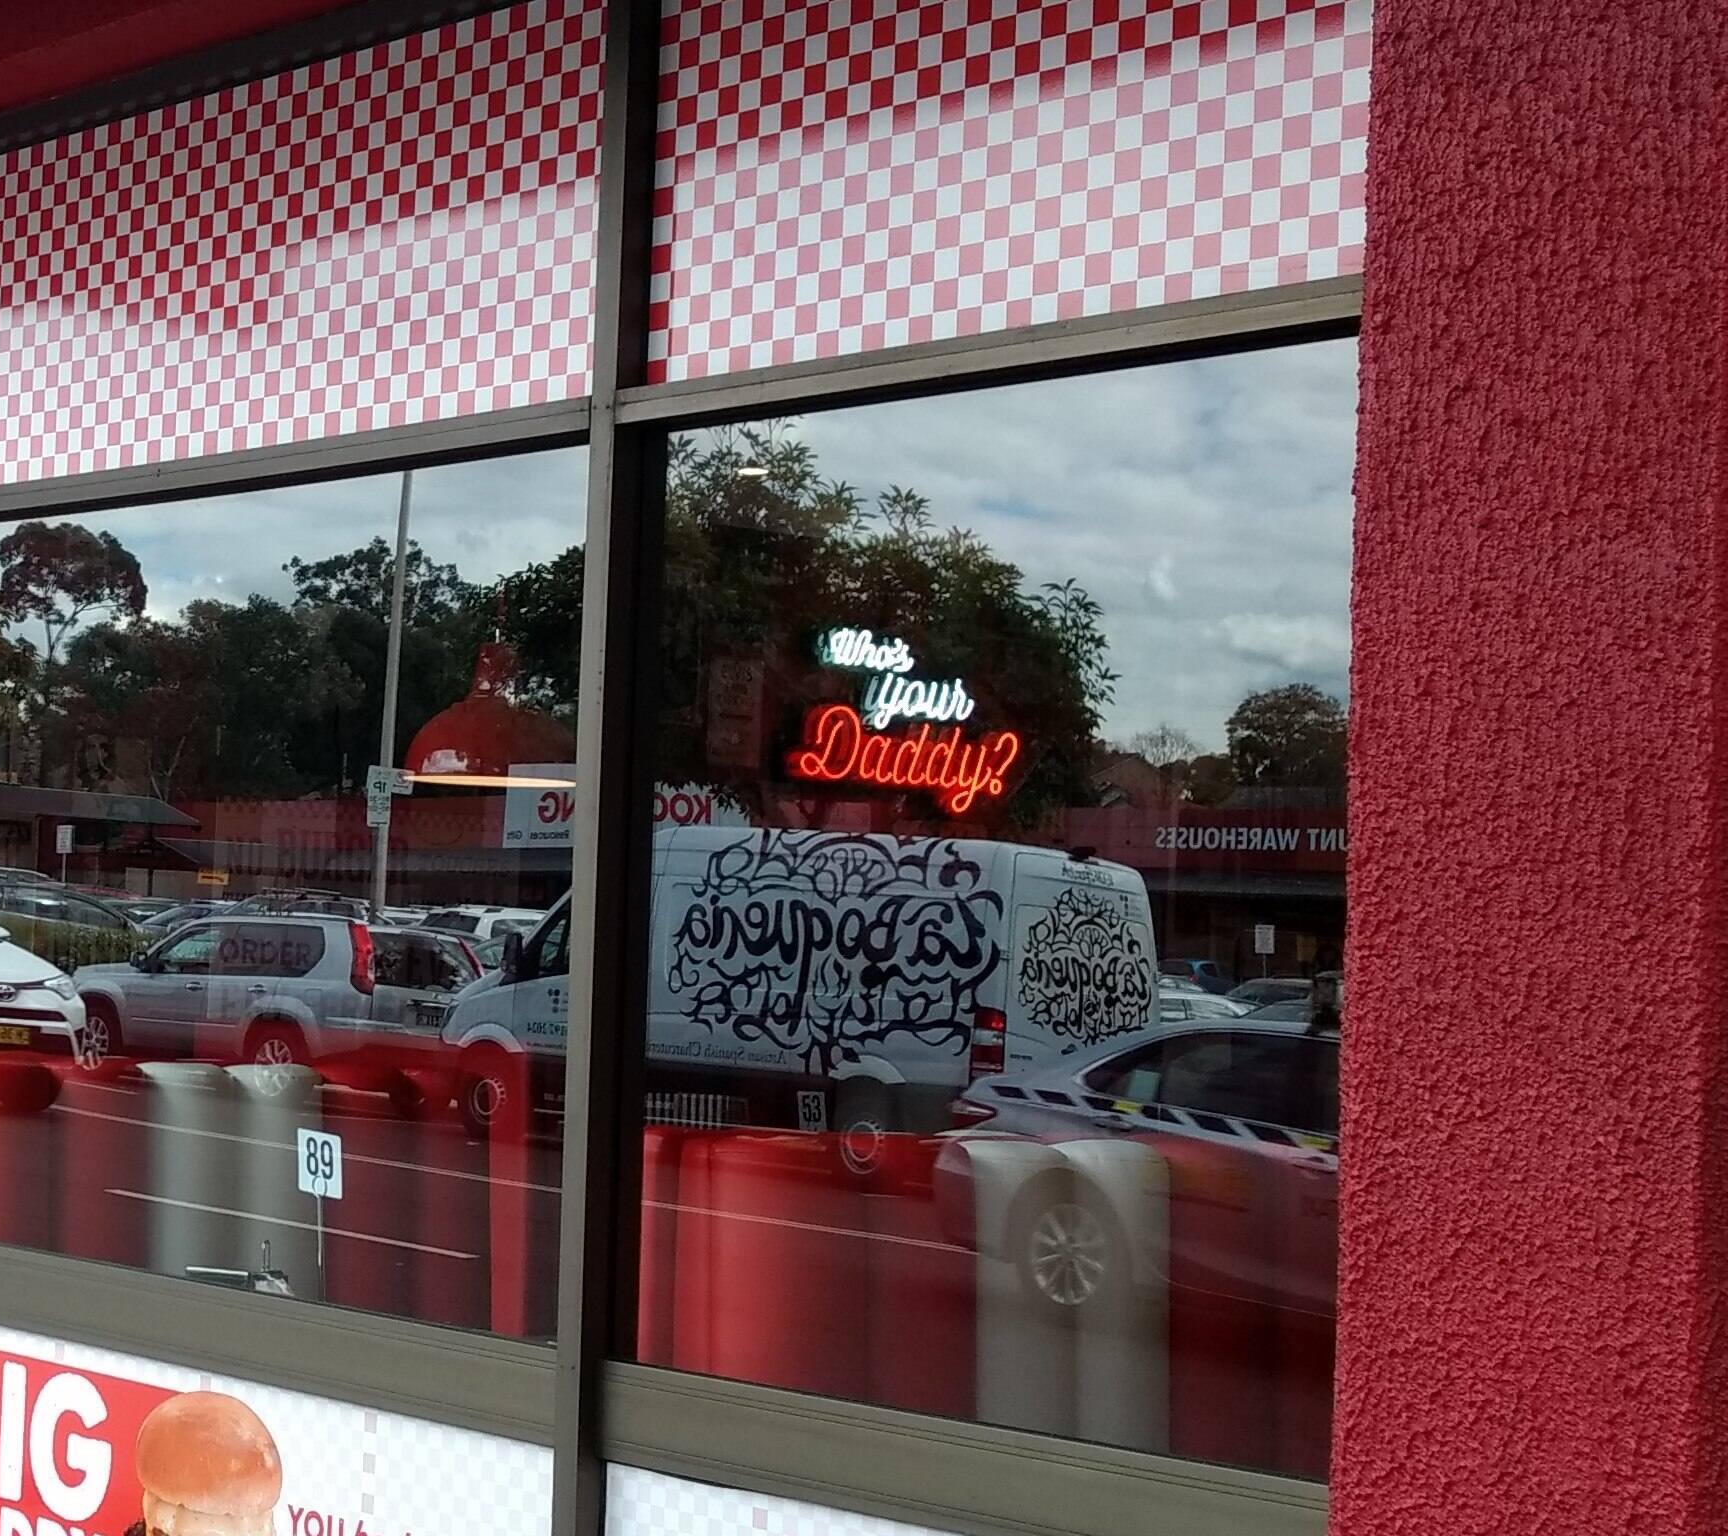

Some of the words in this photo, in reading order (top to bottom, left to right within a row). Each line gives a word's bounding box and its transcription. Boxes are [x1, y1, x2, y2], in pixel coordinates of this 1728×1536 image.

[822, 627, 916, 673] Who's
[868, 673, 976, 730] your
[799, 705, 1019, 814] Daddy?
[802, 1094, 822, 1123] 53
[304, 1137, 335, 1181] 89
